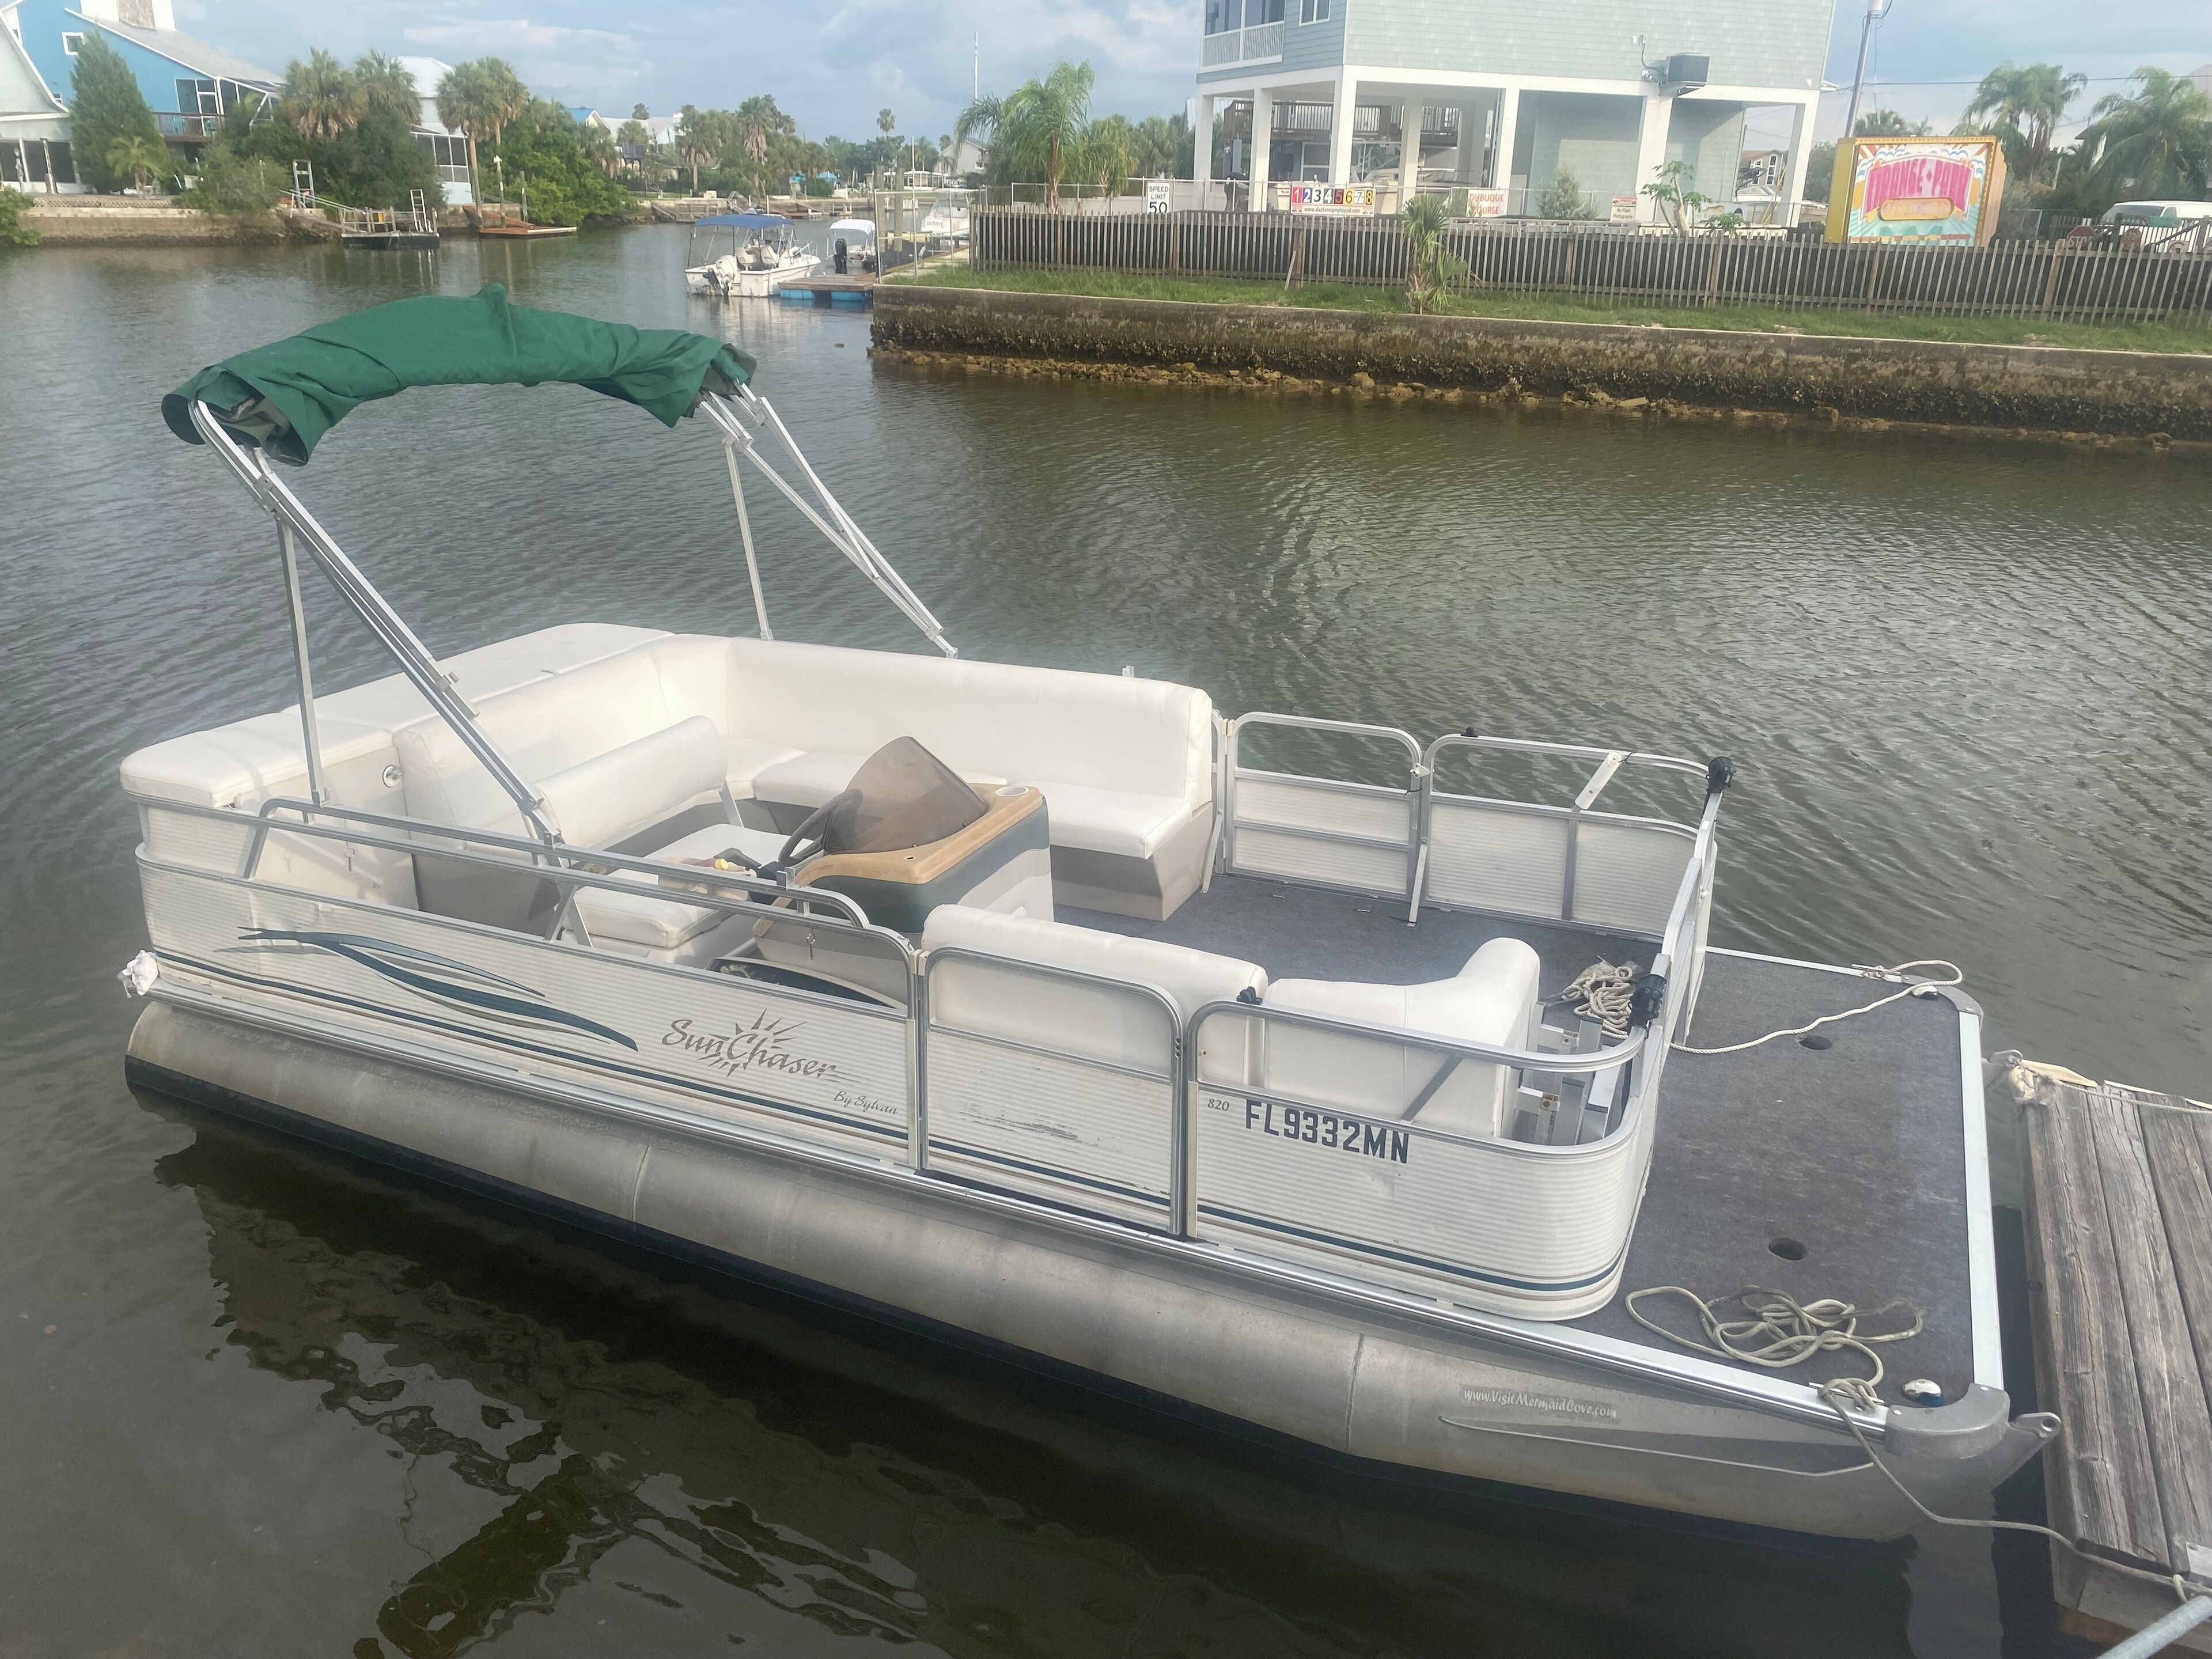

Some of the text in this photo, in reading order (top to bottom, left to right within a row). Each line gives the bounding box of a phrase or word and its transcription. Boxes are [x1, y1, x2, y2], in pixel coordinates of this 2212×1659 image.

[1469, 193, 1504, 202] DUBUQUE
[1149, 202, 1167, 214] 50
[1471, 206, 1499, 215] OURSE
[2069, 236, 2093, 247] STO
[2123, 232, 2141, 240] STOP
[661, 1018, 837, 1078] SunChaser
[833, 1090, 899, 1115] By Sylvan
[1207, 1098, 1229, 1111] 820
[1245, 1099, 1410, 1164] FL9332MN
[1464, 1389, 1616, 1418] www.VisitMermaidCove.com
